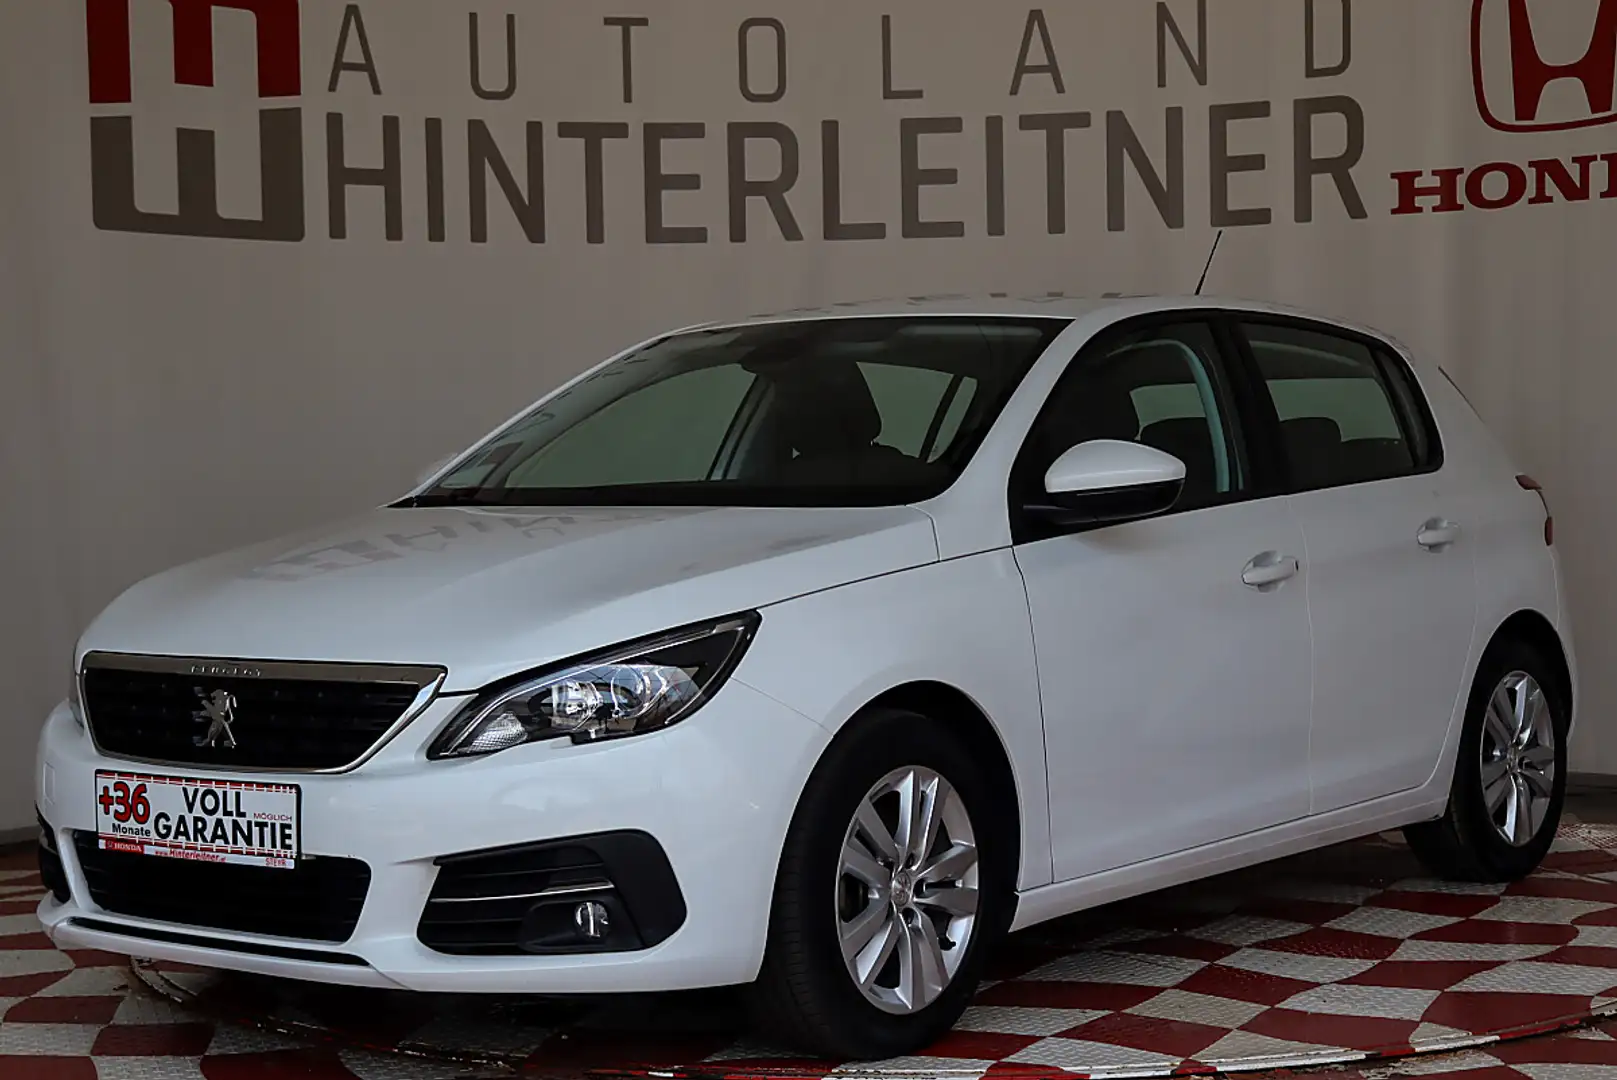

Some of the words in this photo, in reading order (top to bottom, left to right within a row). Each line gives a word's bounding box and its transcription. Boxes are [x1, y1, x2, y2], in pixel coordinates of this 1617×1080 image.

[326, 94, 1368, 244] HINTERLEITNER
[1389, 151, 1617, 215] HON
[182, 786, 247, 818] VOLL
[111, 822, 151, 838] Monate
[114, 842, 143, 853] HONDA
[153, 811, 293, 851] GARANTIE
